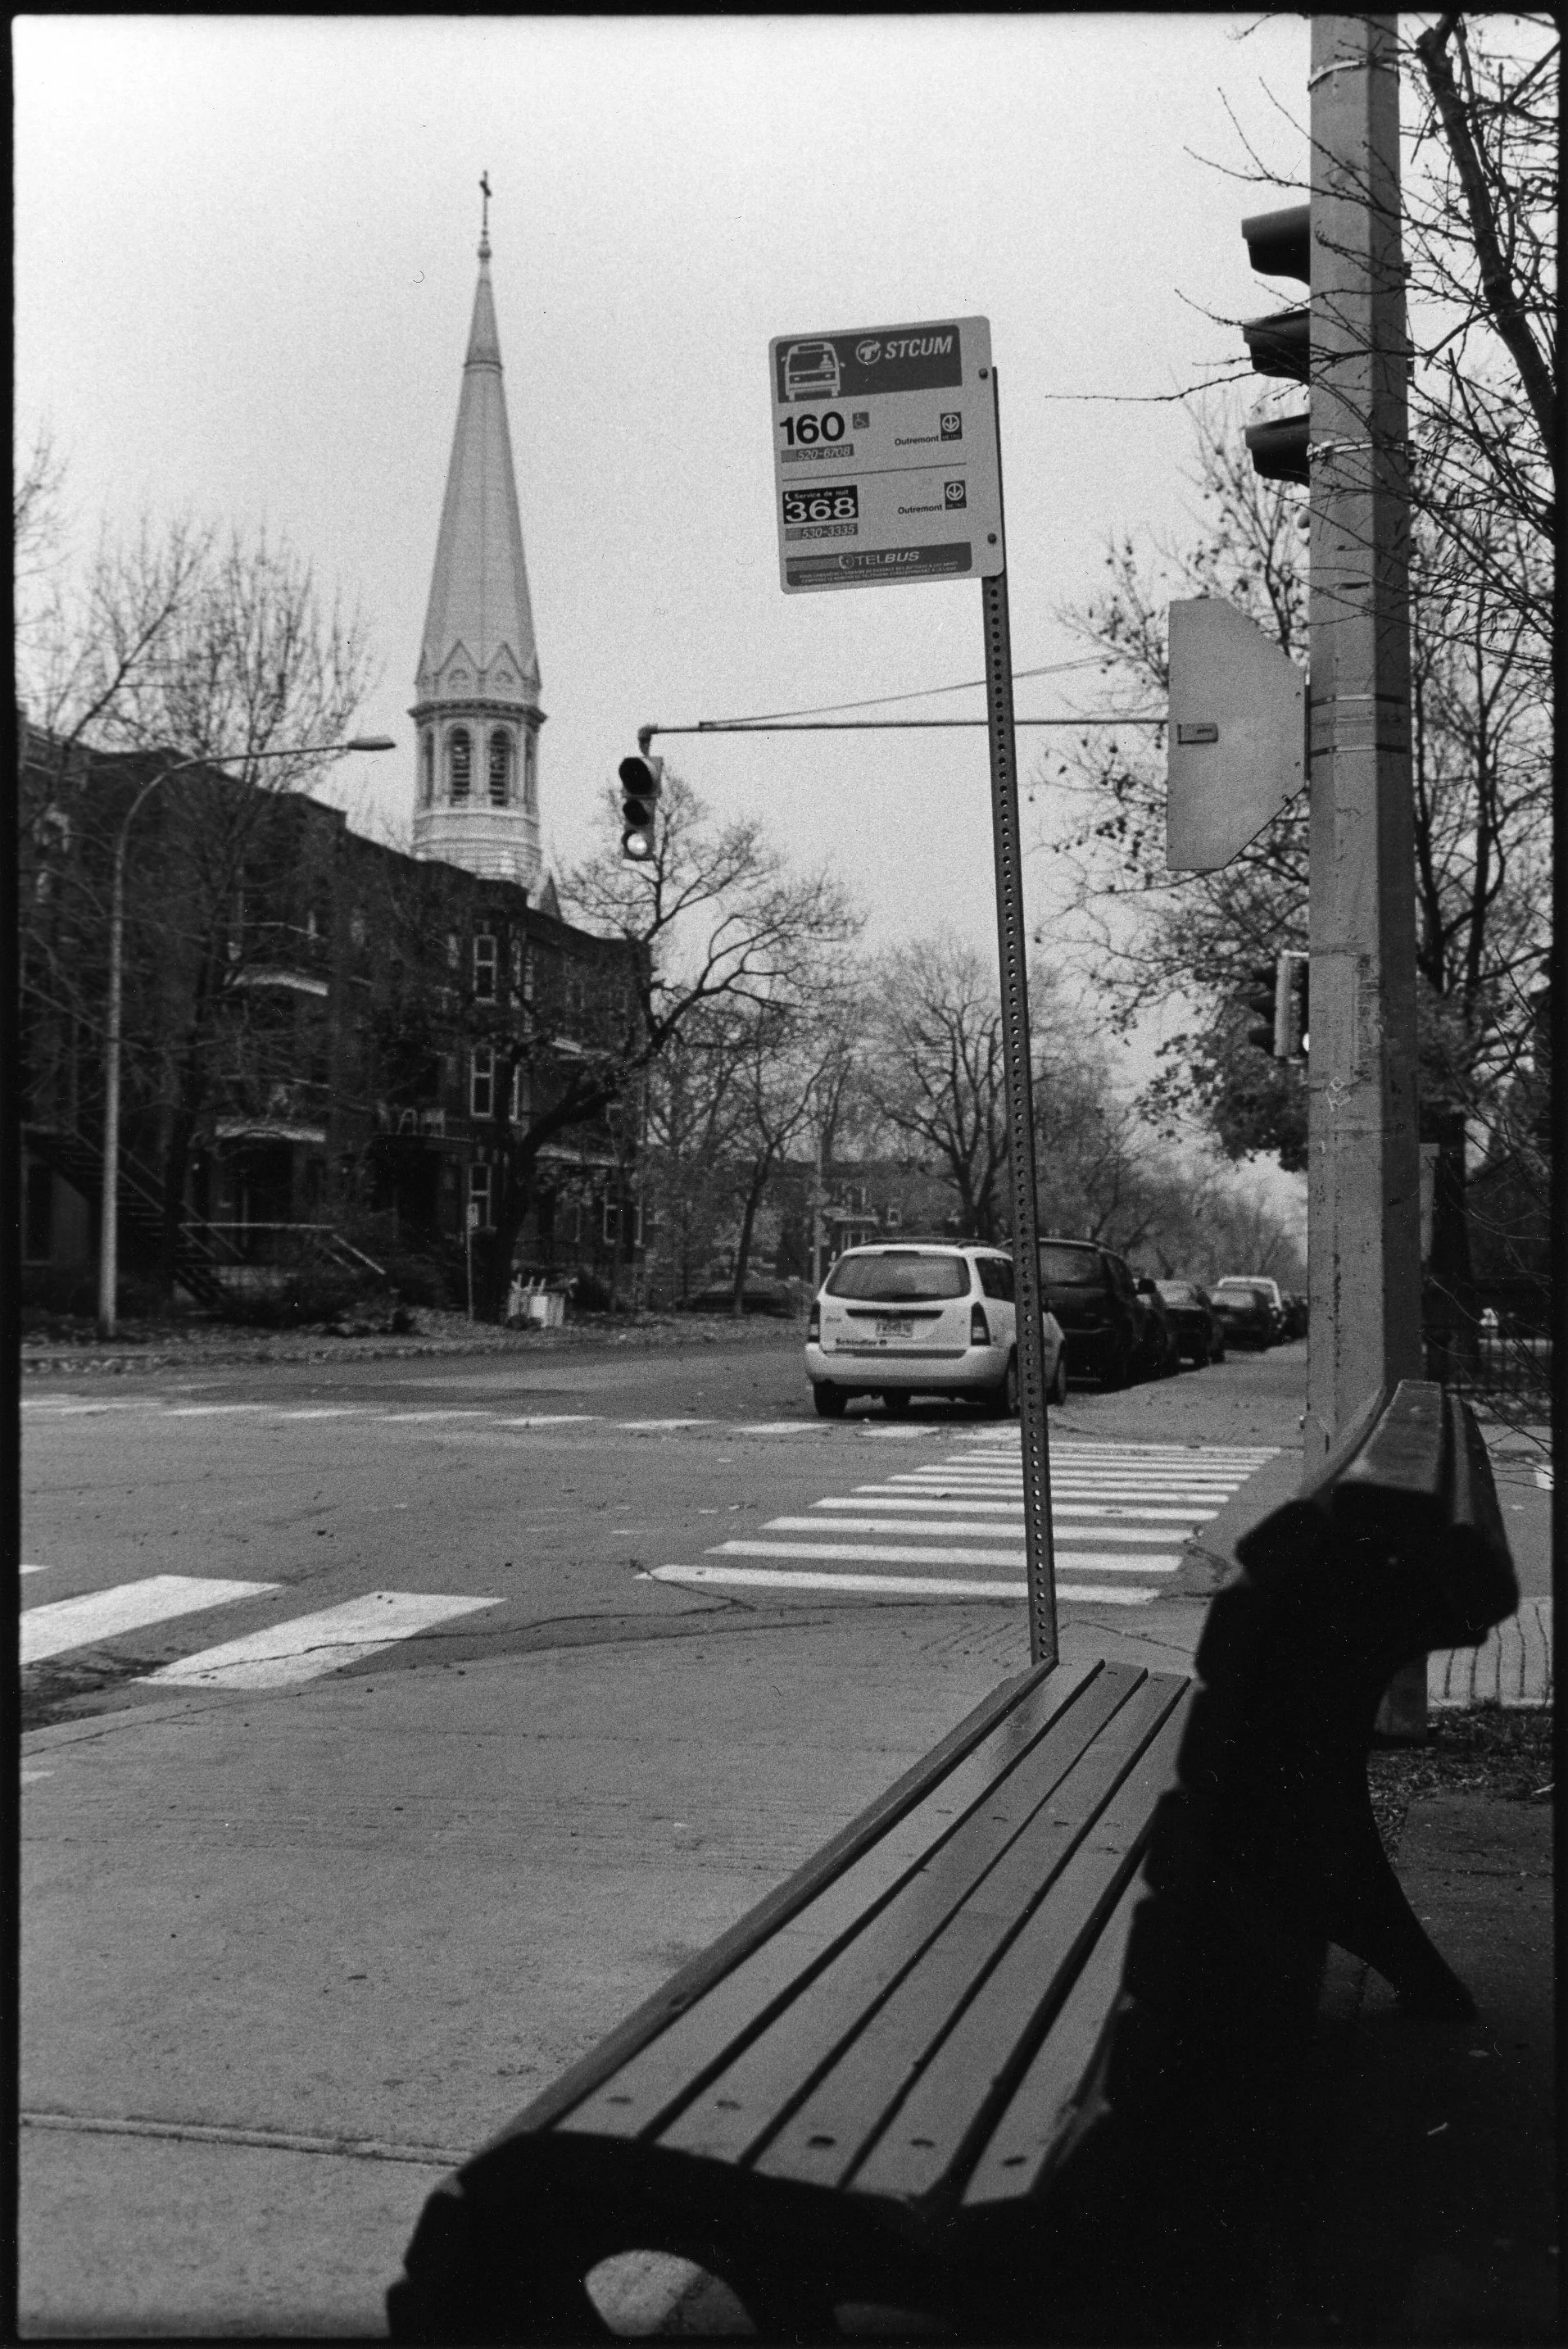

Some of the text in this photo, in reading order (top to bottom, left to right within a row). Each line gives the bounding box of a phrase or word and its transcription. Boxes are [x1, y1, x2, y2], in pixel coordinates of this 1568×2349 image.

[885, 335, 954, 360] STCUM
[780, 411, 845, 445] 160
[895, 435, 940, 446] Outremont
[797, 446, 851, 460] 520-6708
[786, 497, 856, 522] 368
[898, 504, 942, 515] Outremont
[802, 524, 855, 538] 530-3335
[854, 551, 920, 566] TELBUS
